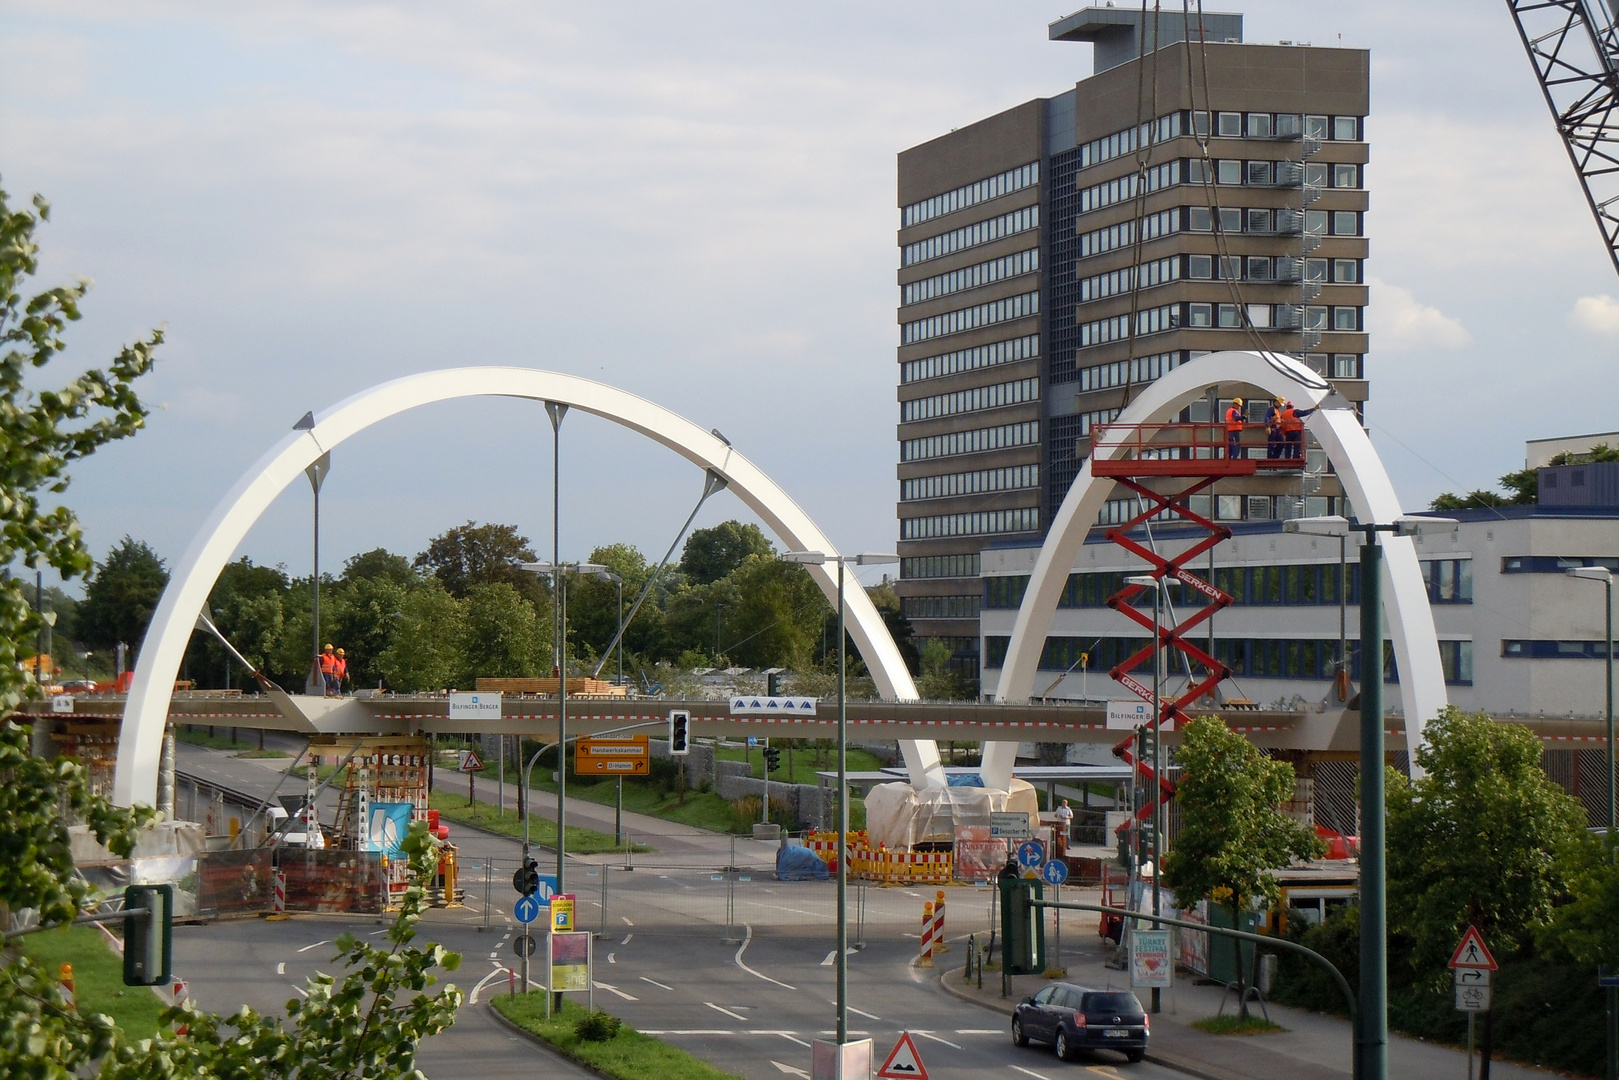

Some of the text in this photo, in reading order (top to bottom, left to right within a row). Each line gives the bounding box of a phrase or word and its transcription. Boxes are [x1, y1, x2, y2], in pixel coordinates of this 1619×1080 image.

[1177, 570, 1221, 599] GERKEN
[1111, 712, 1144, 720] BILFINGER
[1139, 937, 1165, 945] TÜRKEI
